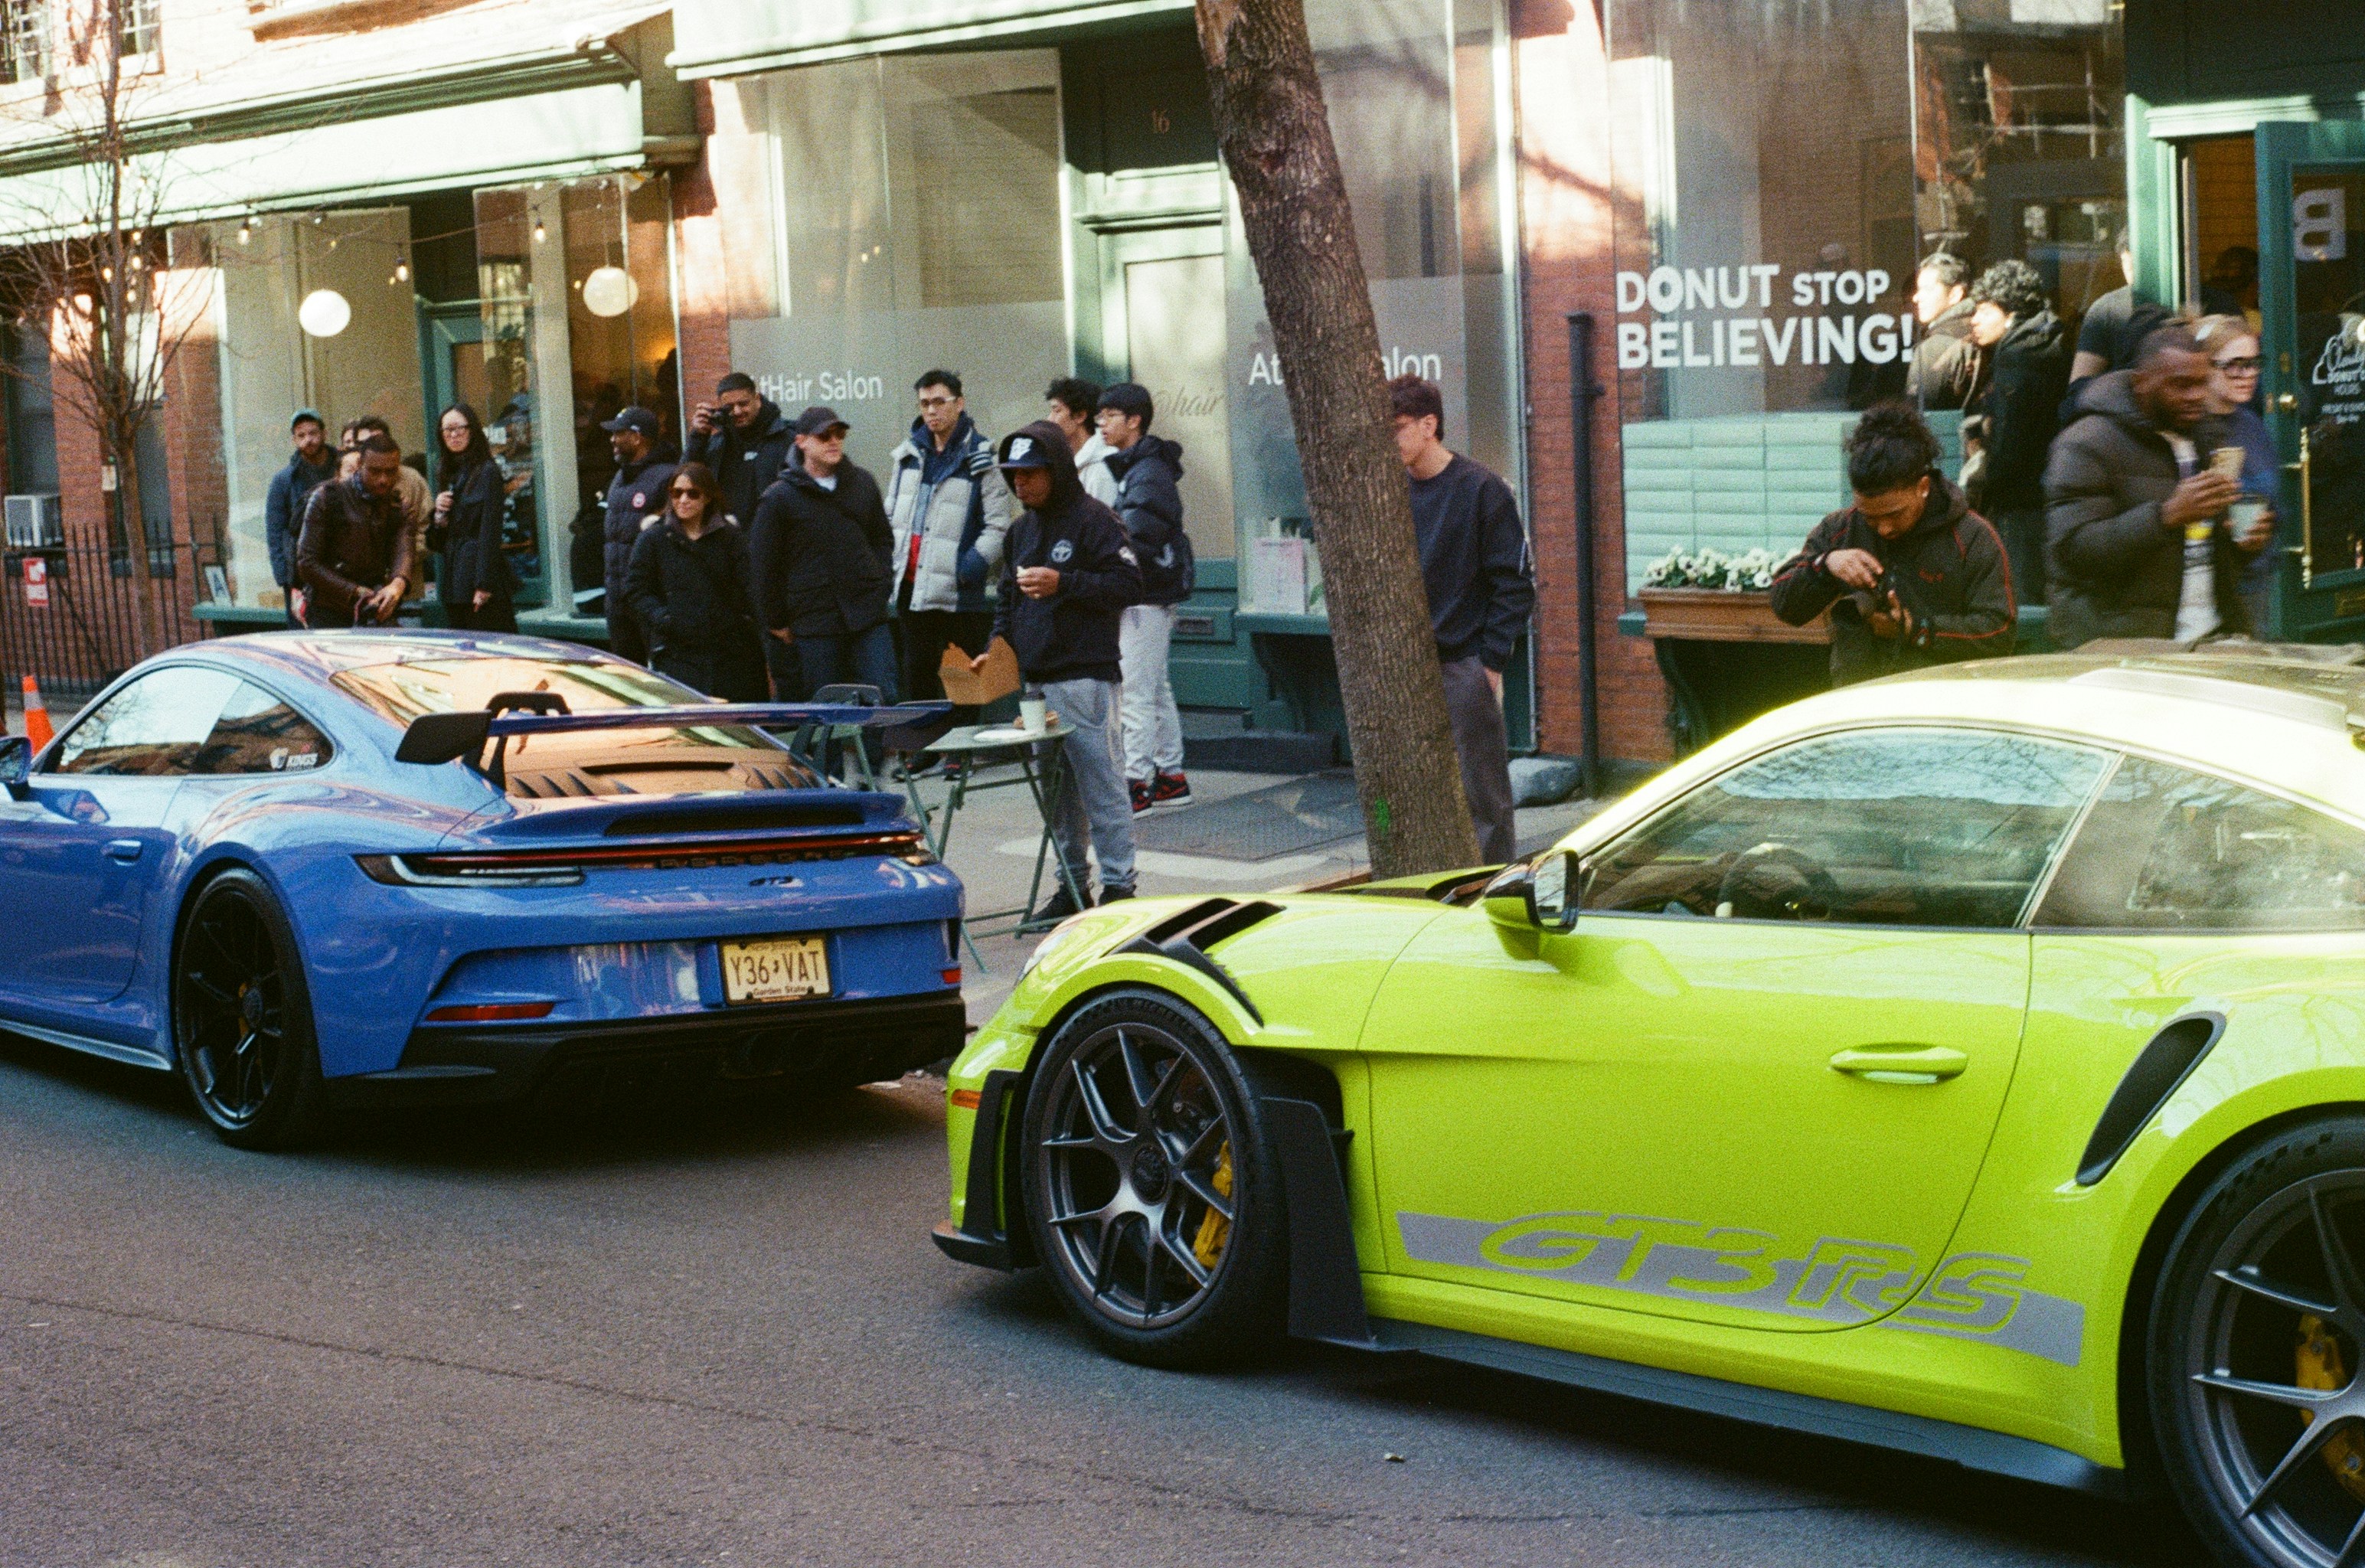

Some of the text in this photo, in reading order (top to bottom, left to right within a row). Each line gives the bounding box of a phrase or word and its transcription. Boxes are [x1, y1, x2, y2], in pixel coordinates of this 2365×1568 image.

[1616, 264, 1891, 313] DONUT STOP
[1617, 312, 1915, 369] BELIEVING!
[750, 368, 883, 403] tHair Salon
[749, 876, 794, 887] GT3
